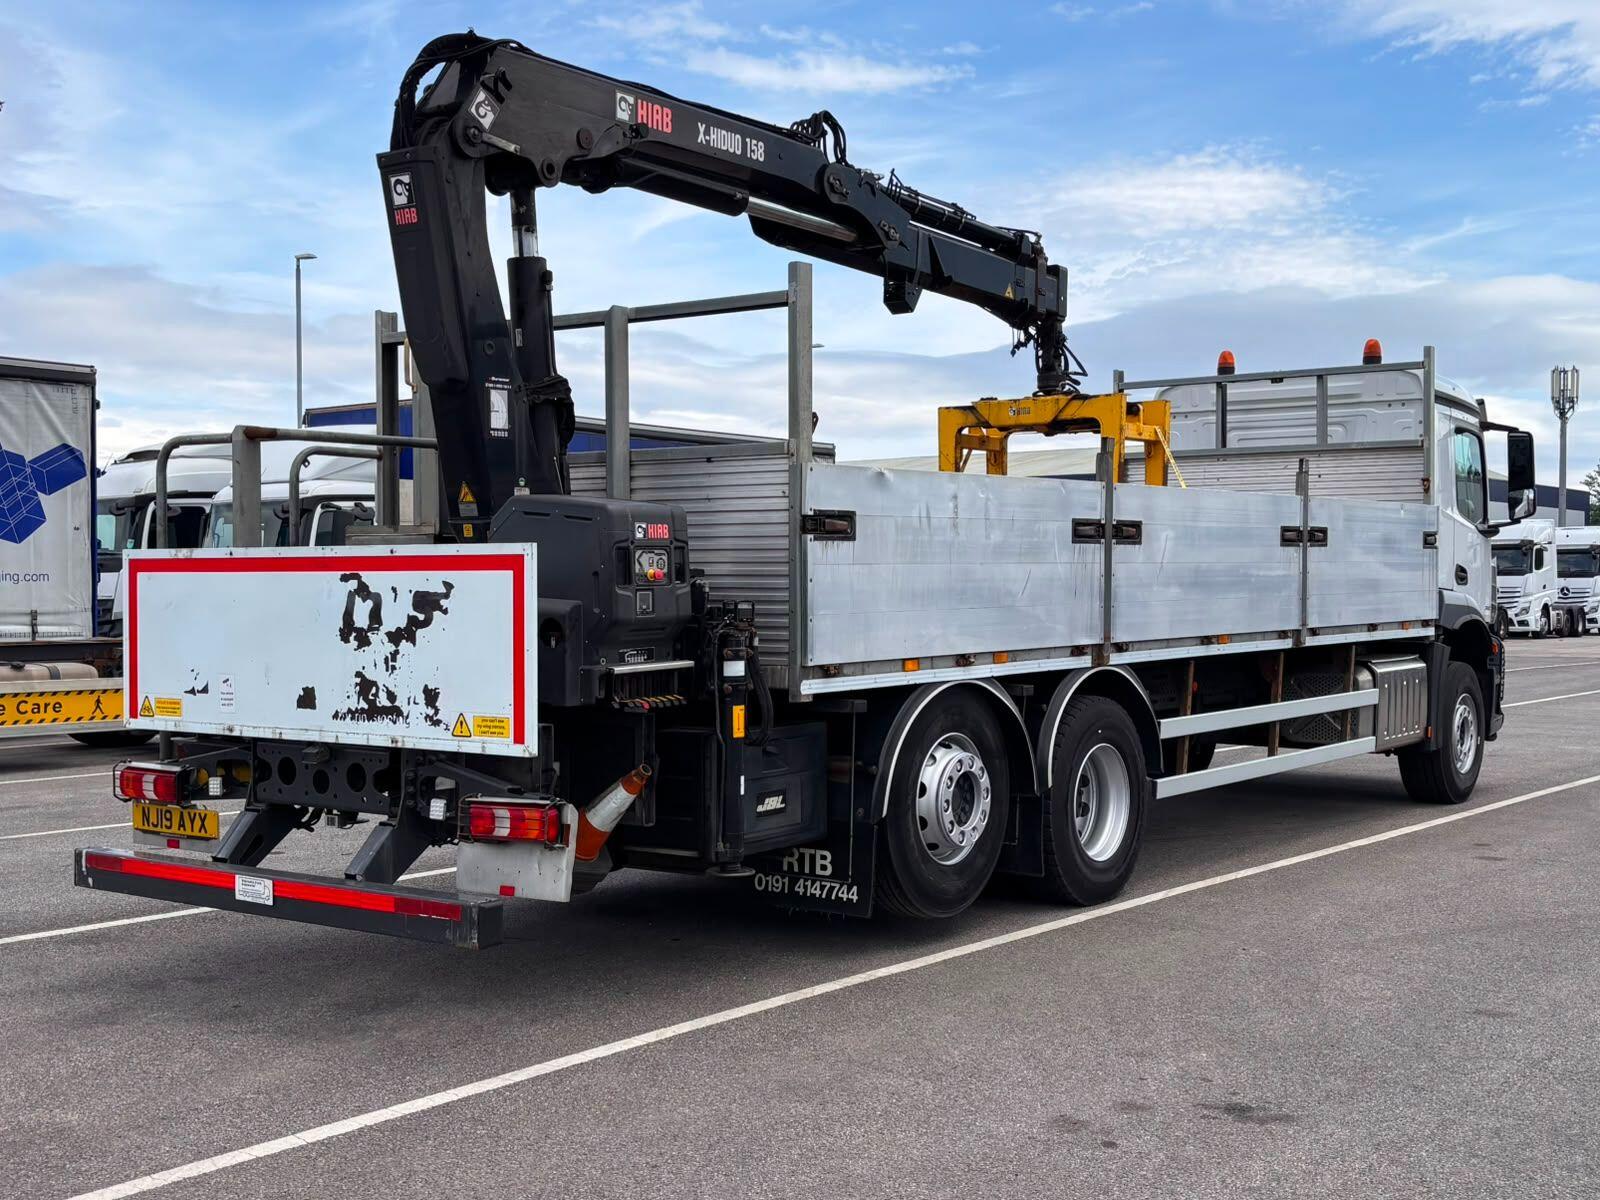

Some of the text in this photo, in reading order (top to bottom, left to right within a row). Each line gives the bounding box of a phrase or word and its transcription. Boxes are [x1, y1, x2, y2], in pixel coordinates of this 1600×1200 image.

[637, 99, 673, 134] HIAB
[697, 122, 765, 162] X-HIDUO 158
[394, 207, 418, 226] HIAB
[647, 523, 670, 539] HIAB
[0, 570, 50, 585] ing.com
[16, 700, 63, 715] Care
[142, 806, 208, 834] NJ19 AYX
[783, 847, 833, 877] RTB
[754, 873, 858, 904] 0191 4147744
